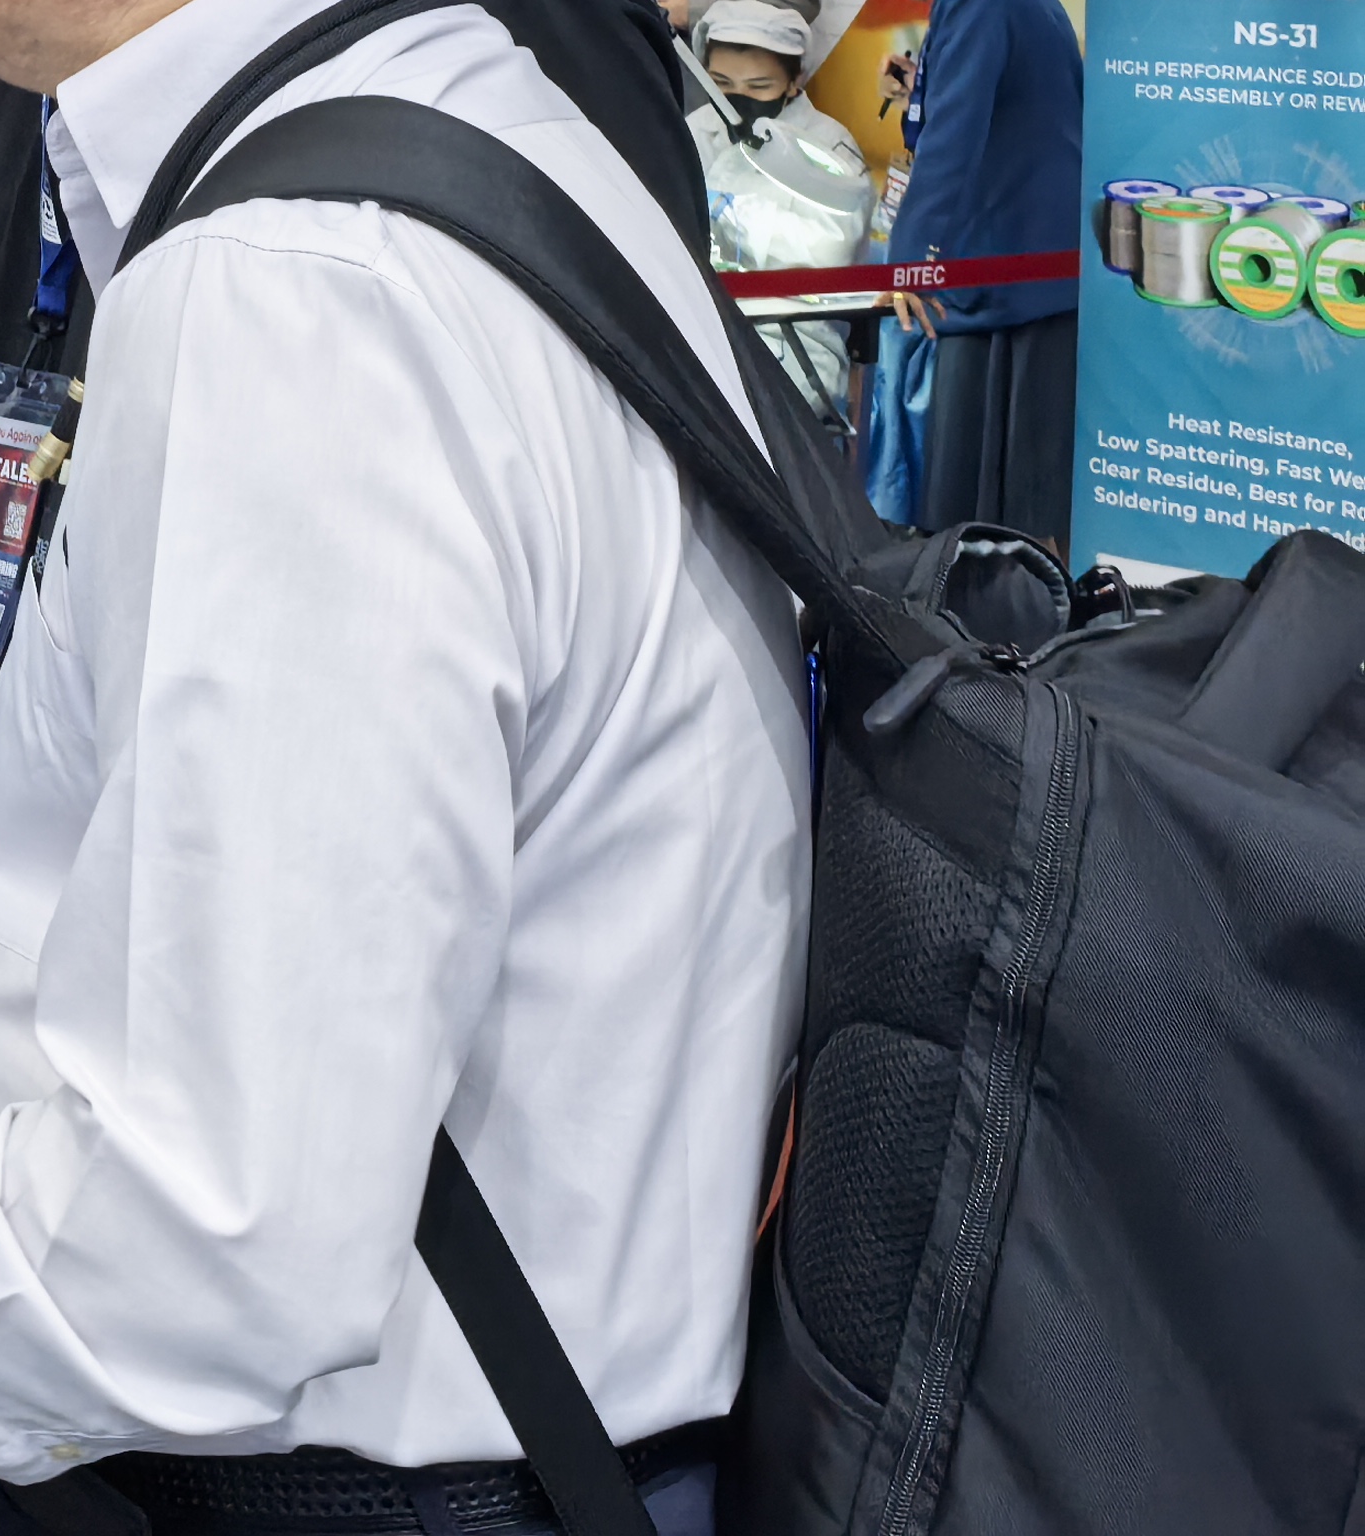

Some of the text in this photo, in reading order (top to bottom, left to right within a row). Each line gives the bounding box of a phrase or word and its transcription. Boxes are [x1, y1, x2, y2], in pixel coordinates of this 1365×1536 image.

[1233, 20, 1318, 49] NS-31
[1105, 58, 1149, 76] HIGH
[1155, 61, 1308, 85] PERFORMANCE
[1135, 83, 1173, 101] FOR
[1178, 86, 1285, 109] ASSEMBLY
[1289, 93, 1317, 110] OR
[893, 265, 946, 289] BITEC
[6, 426, 32, 444] Again
[1168, 412, 1354, 461] Heat Resistance,
[1097, 429, 1140, 453] Low
[1145, 438, 1270, 477] Spattering,
[1276, 458, 1322, 483] Fast
[1089, 457, 1141, 481] Clear
[1147, 467, 1243, 501] Residue,
[1248, 483, 1298, 509] Best
[1303, 492, 1336, 514] for
[1093, 485, 1198, 524] Soldering
[1204, 506, 1246, 529] and
